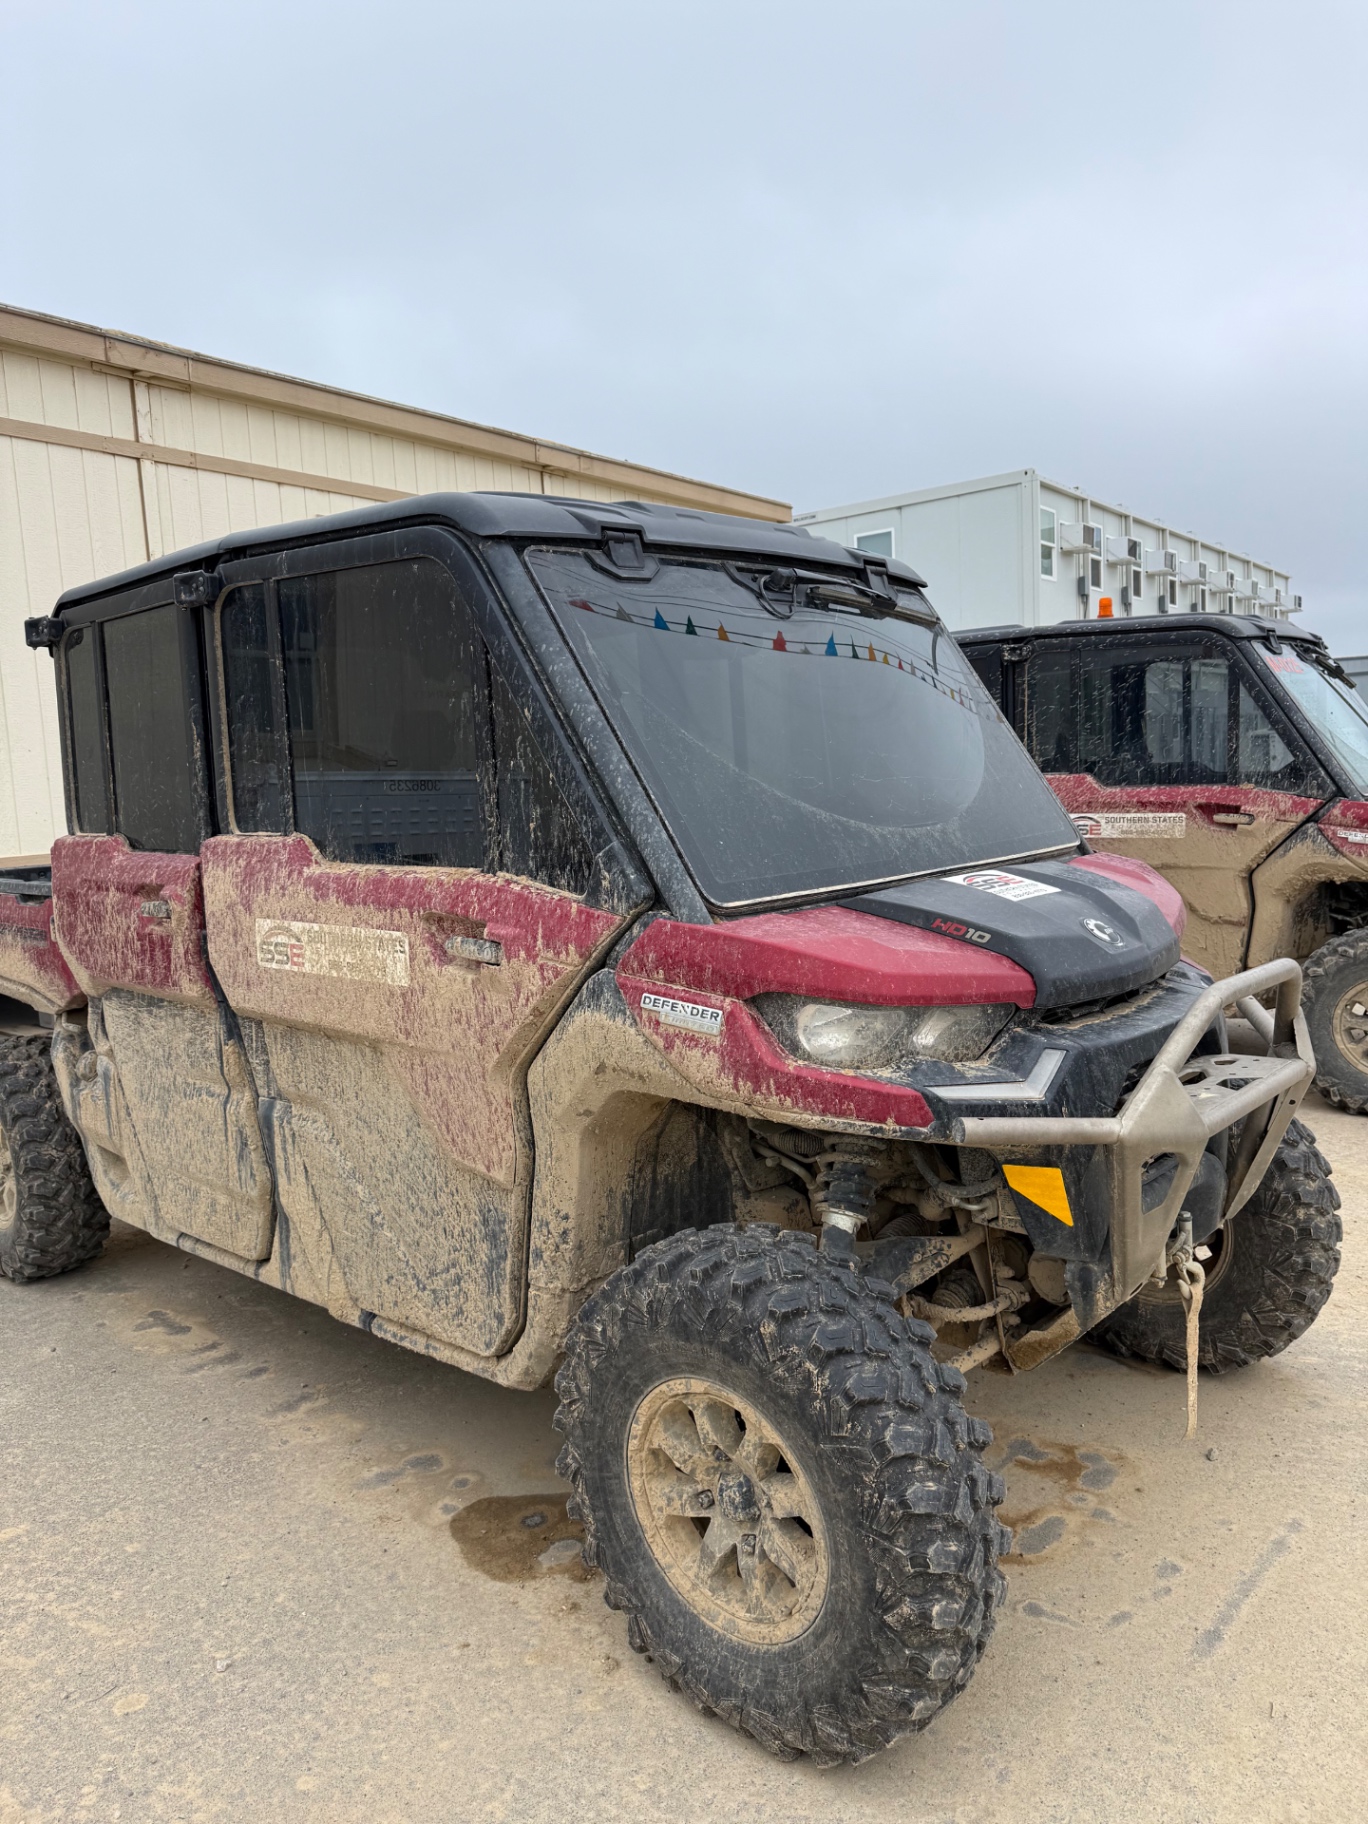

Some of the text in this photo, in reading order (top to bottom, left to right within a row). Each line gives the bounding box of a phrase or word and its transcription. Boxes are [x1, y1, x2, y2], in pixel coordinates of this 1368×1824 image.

[1077, 824, 1102, 836] SE
[1104, 816, 1184, 824] SOUTHERN STATES
[931, 917, 992, 944] HD10
[259, 940, 306, 968] SSE
[642, 995, 720, 1022] DEFENDER
